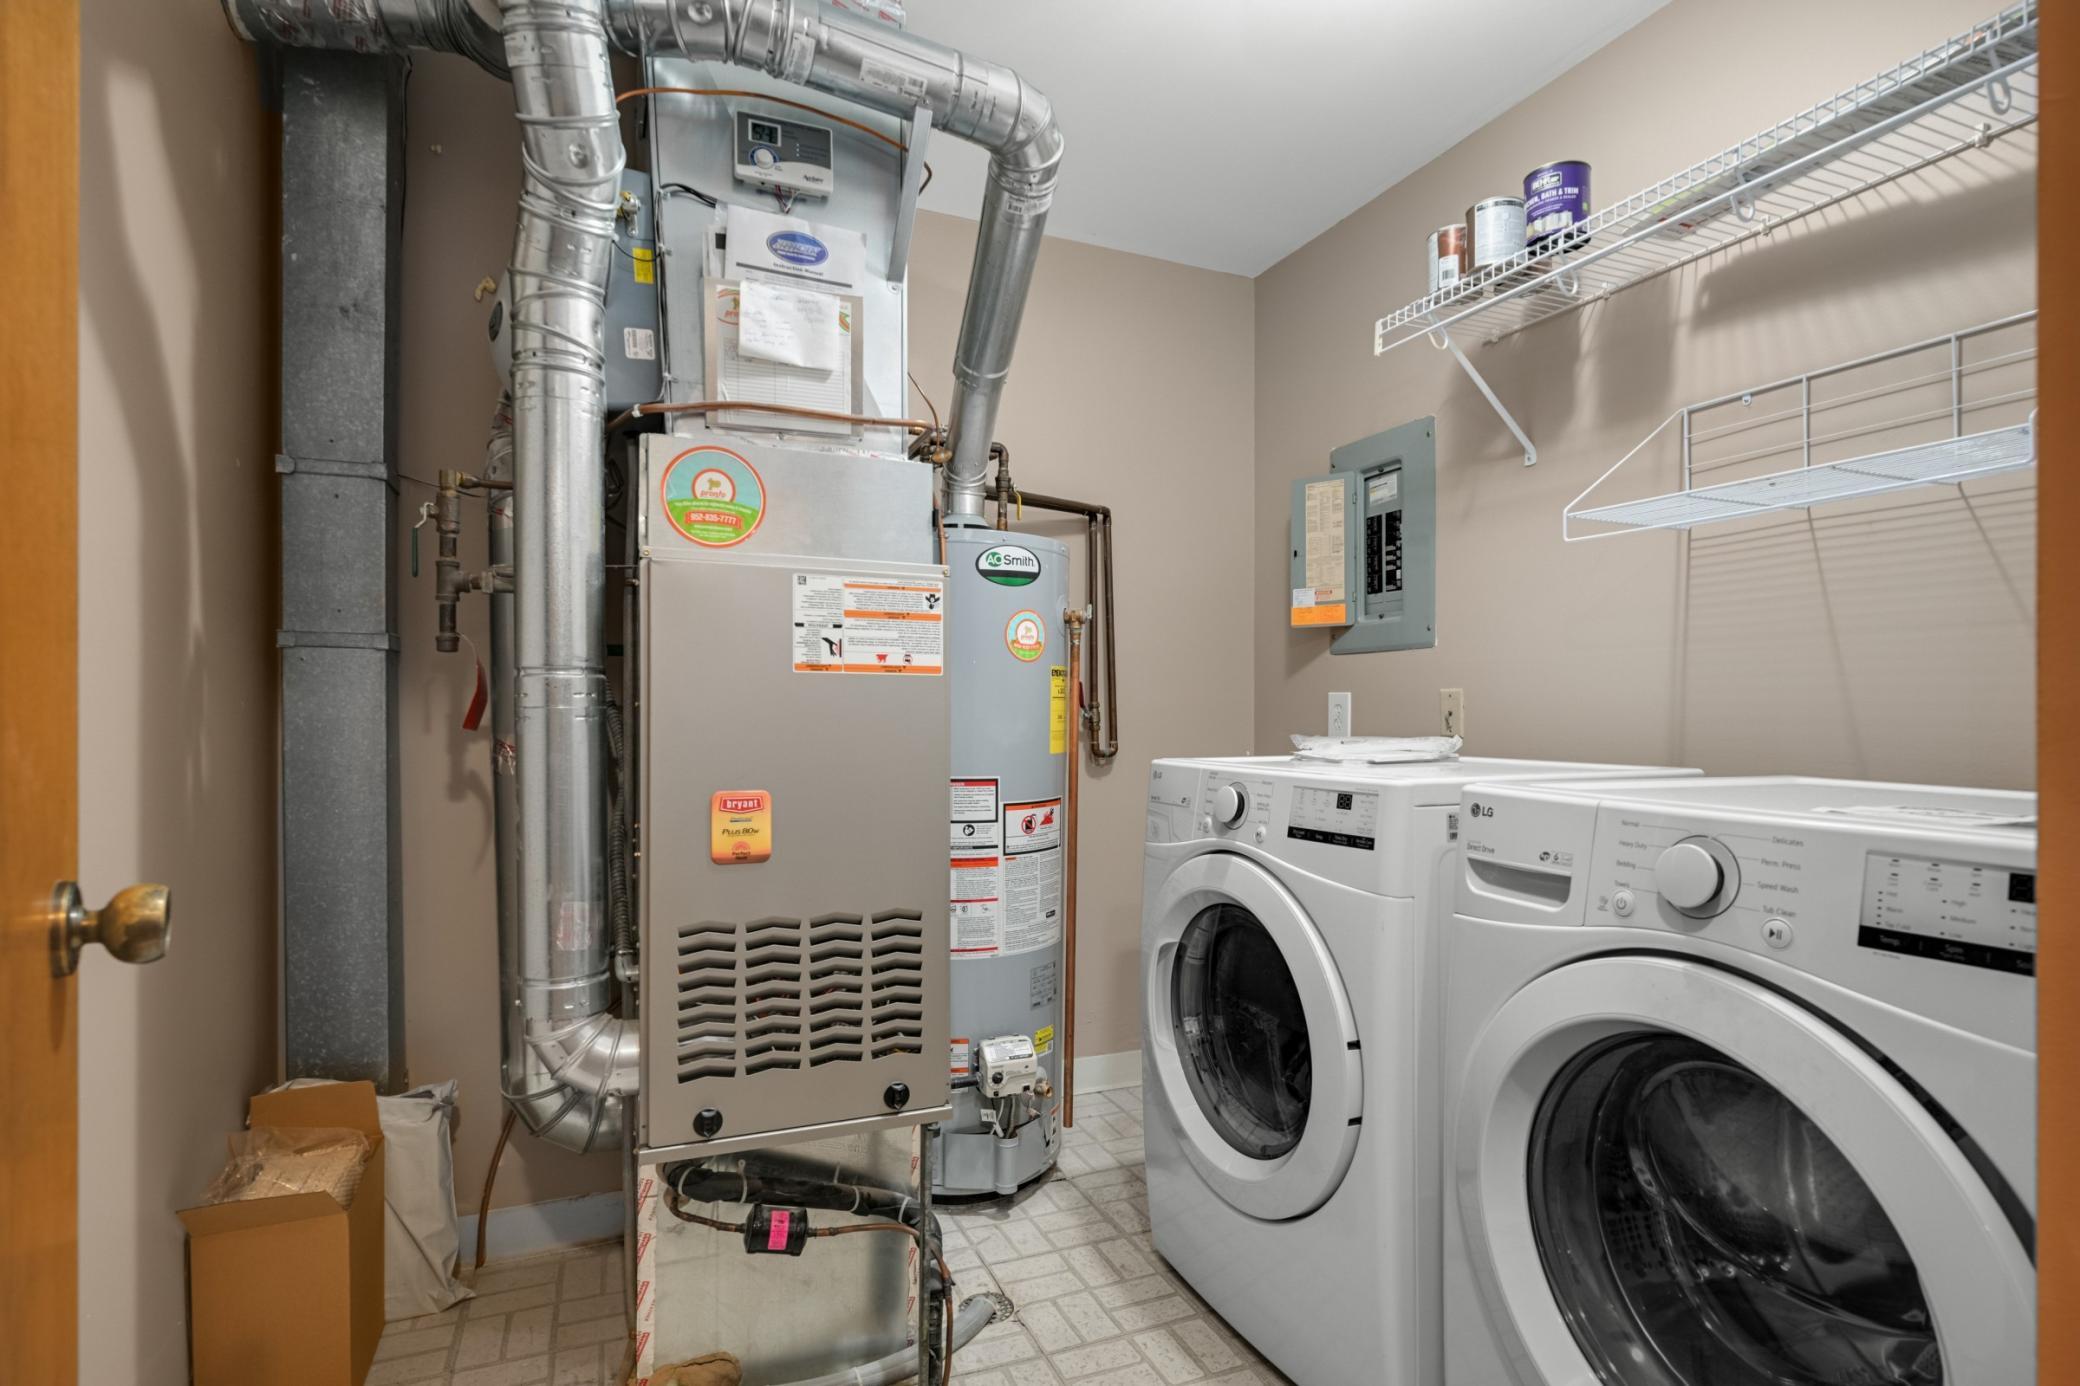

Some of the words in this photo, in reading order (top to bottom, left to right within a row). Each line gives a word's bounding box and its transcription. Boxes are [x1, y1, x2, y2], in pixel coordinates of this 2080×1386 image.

[1003, 554, 1034, 567] Smith
[726, 799, 758, 809] bryant
[1772, 835, 1804, 847] Delicates
[1757, 880, 1778, 891] Speed
[1780, 884, 1799, 894] Wash
